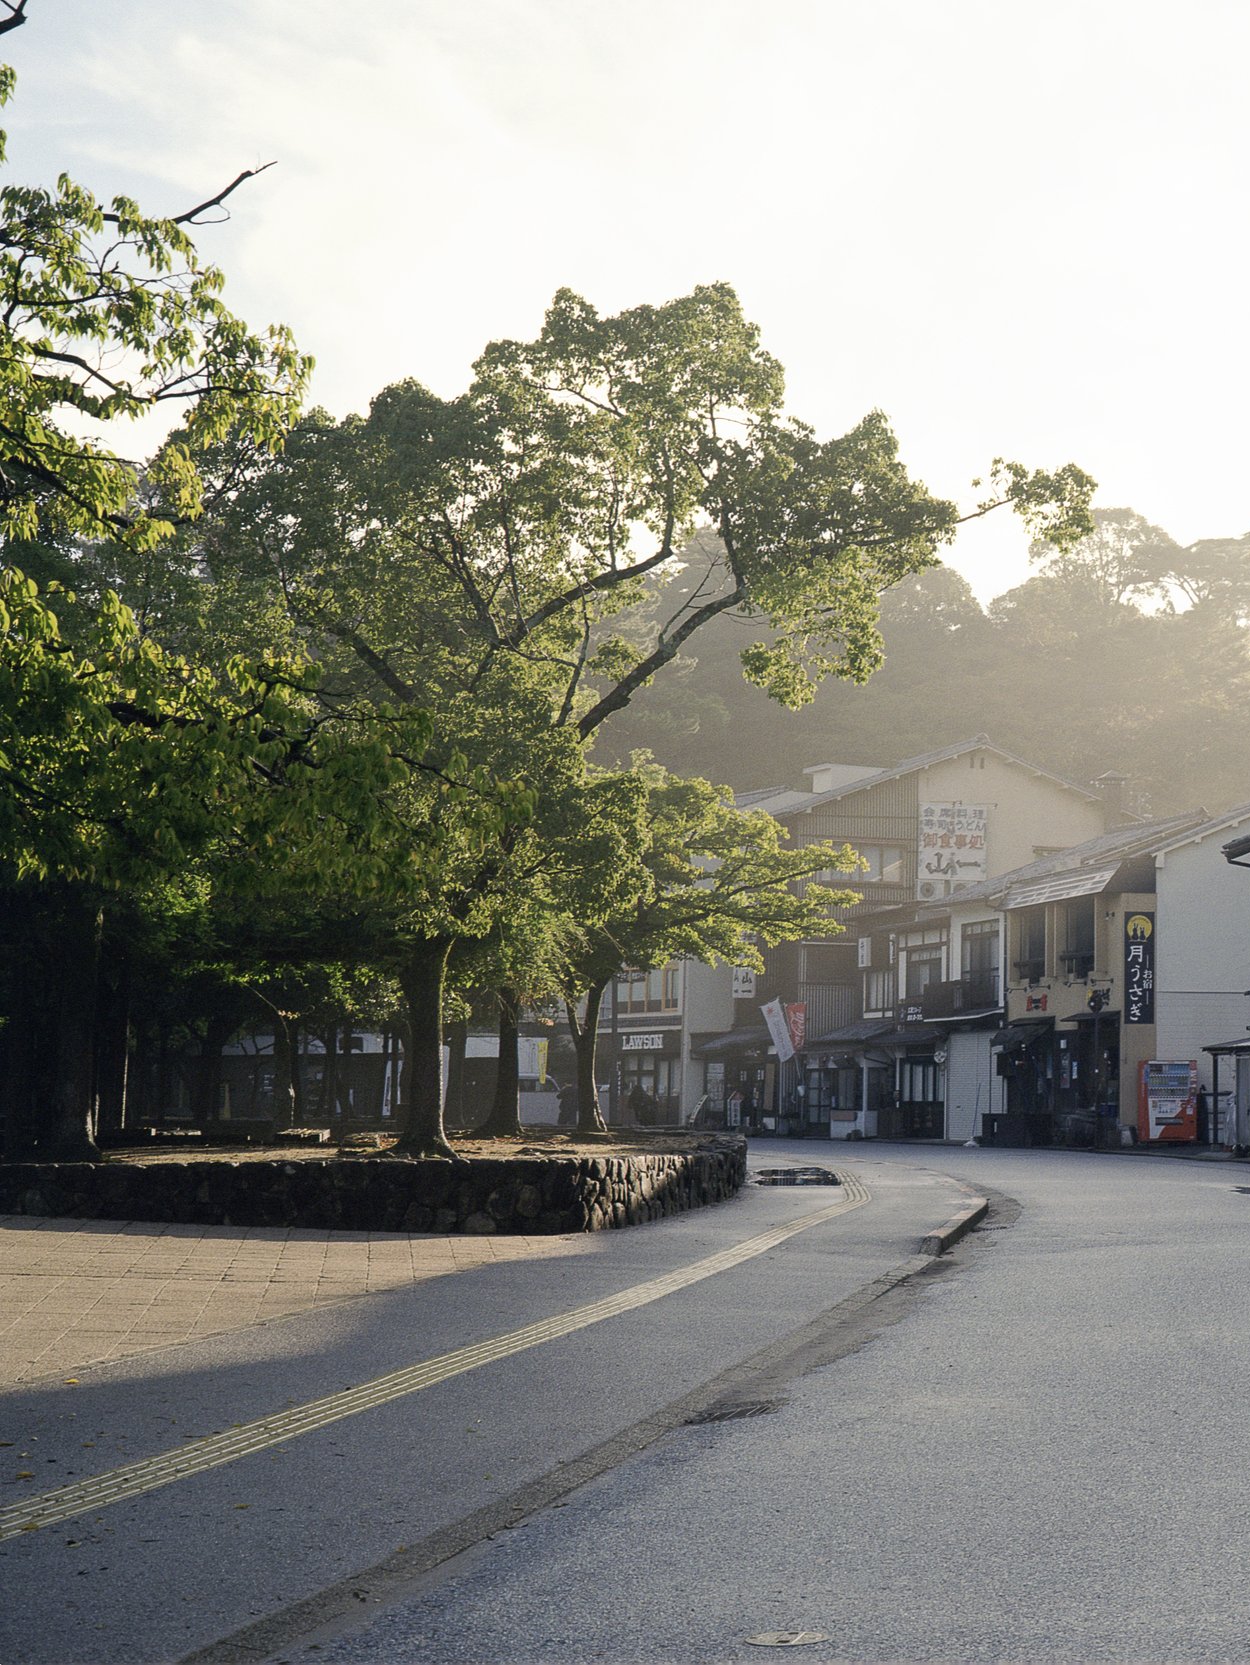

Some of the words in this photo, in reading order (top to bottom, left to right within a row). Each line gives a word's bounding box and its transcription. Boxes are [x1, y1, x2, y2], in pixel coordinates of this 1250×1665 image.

[922, 832, 984, 850] 御食事処
[1127, 945, 1144, 1021] 月うさぎ
[621, 1033, 664, 1051] LAWSON
